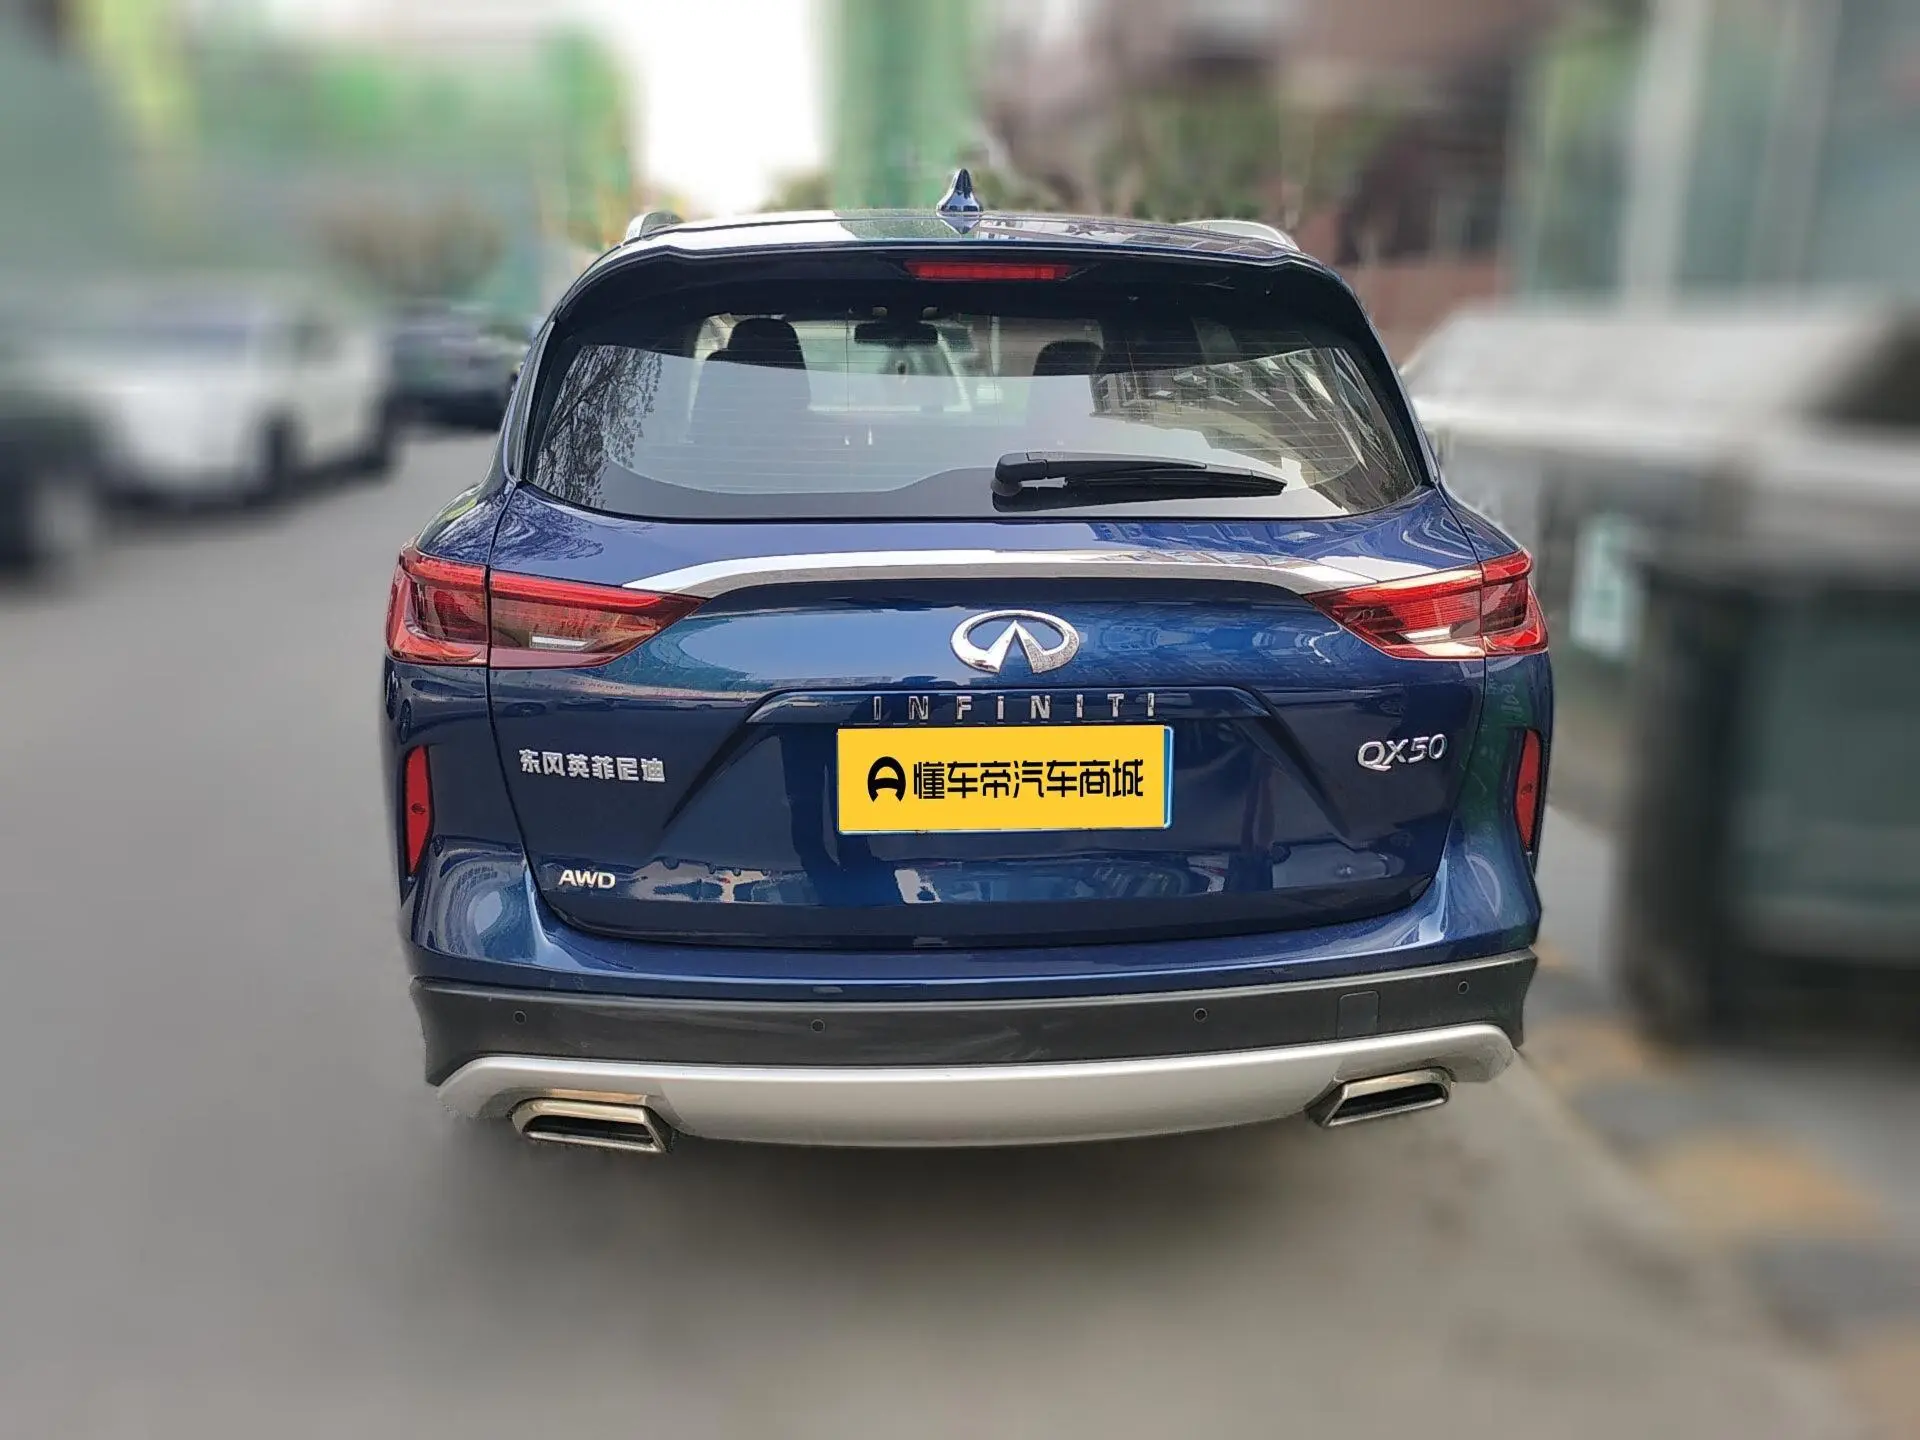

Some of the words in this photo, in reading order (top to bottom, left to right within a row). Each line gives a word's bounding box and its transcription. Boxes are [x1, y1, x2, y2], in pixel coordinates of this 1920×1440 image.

[873, 692, 1156, 720] INFINITI
[518, 749, 666, 782] 东风英菲尼迪
[1357, 733, 1447, 771] QX50
[558, 869, 616, 889] AWD
